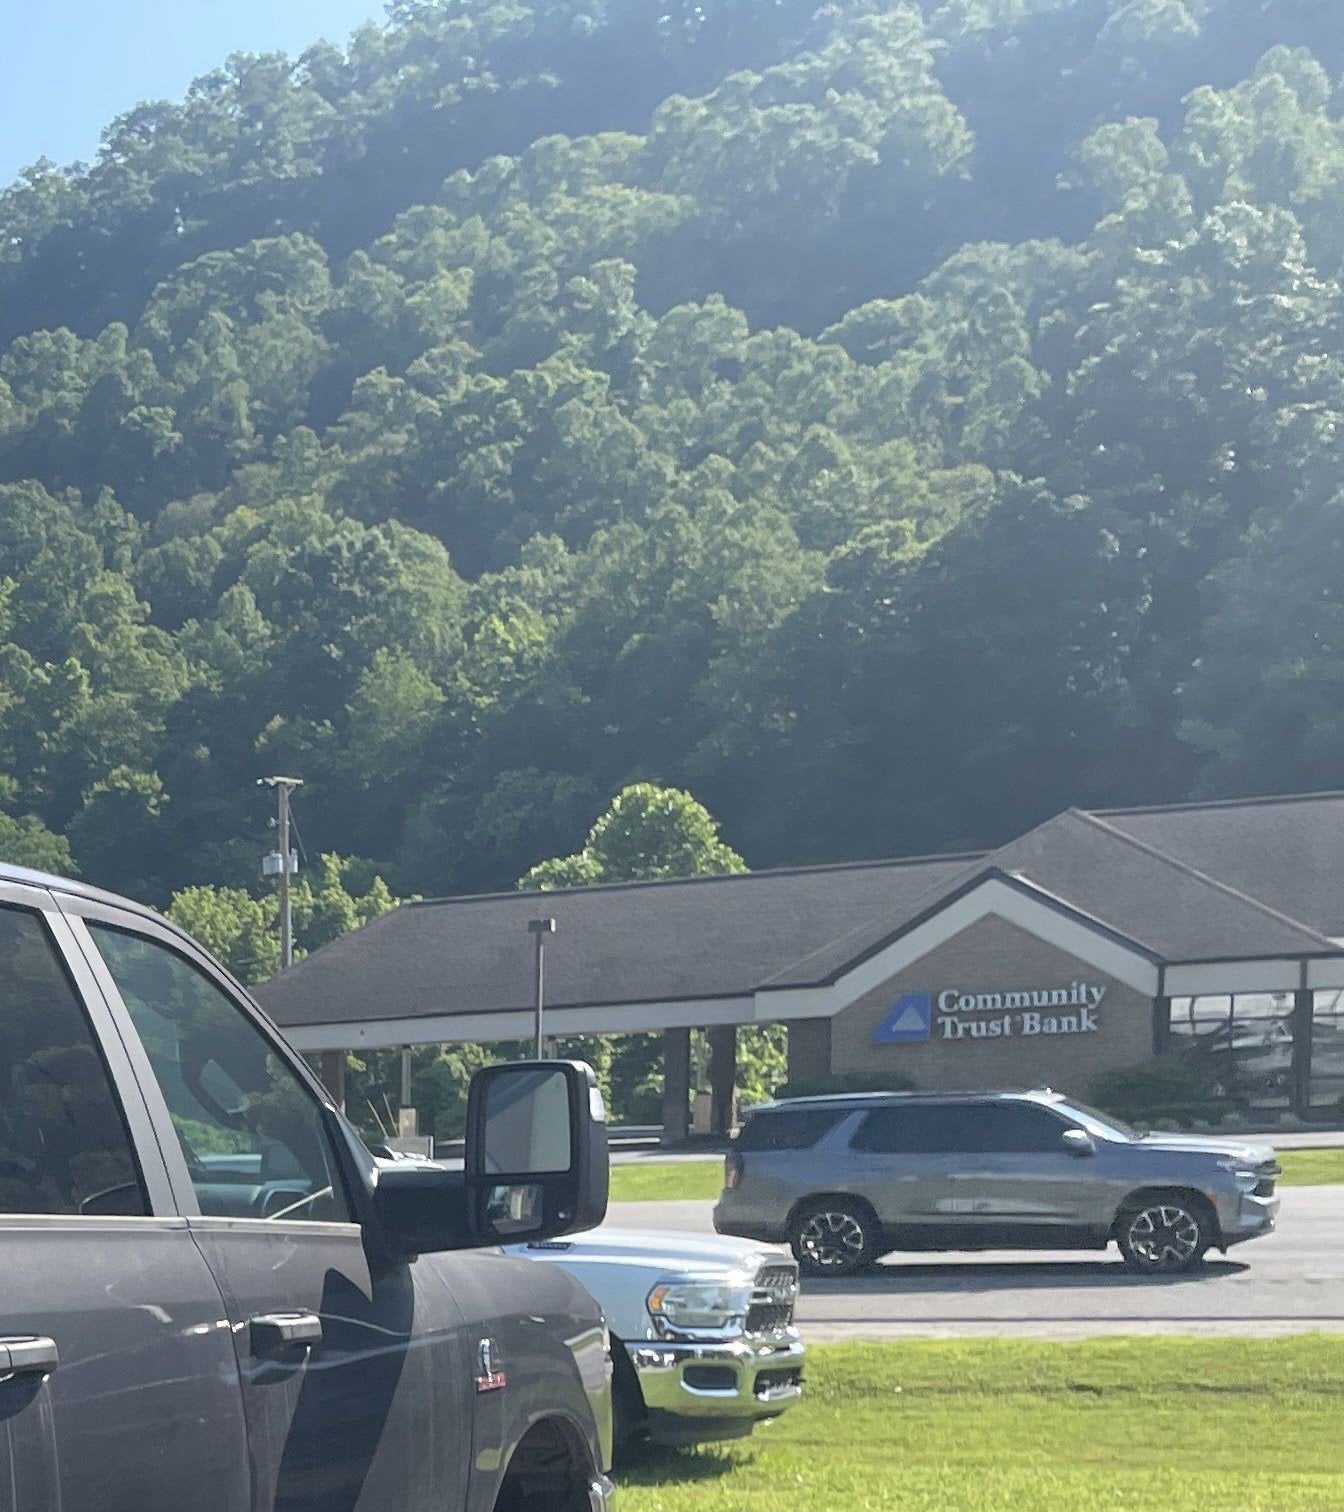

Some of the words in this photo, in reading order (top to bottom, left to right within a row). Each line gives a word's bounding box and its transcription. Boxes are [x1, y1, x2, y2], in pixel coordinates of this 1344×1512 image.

[937, 981, 1107, 1012] Community
[937, 1014, 1011, 1040] Trust
[1021, 1008, 1099, 1036] Bank
